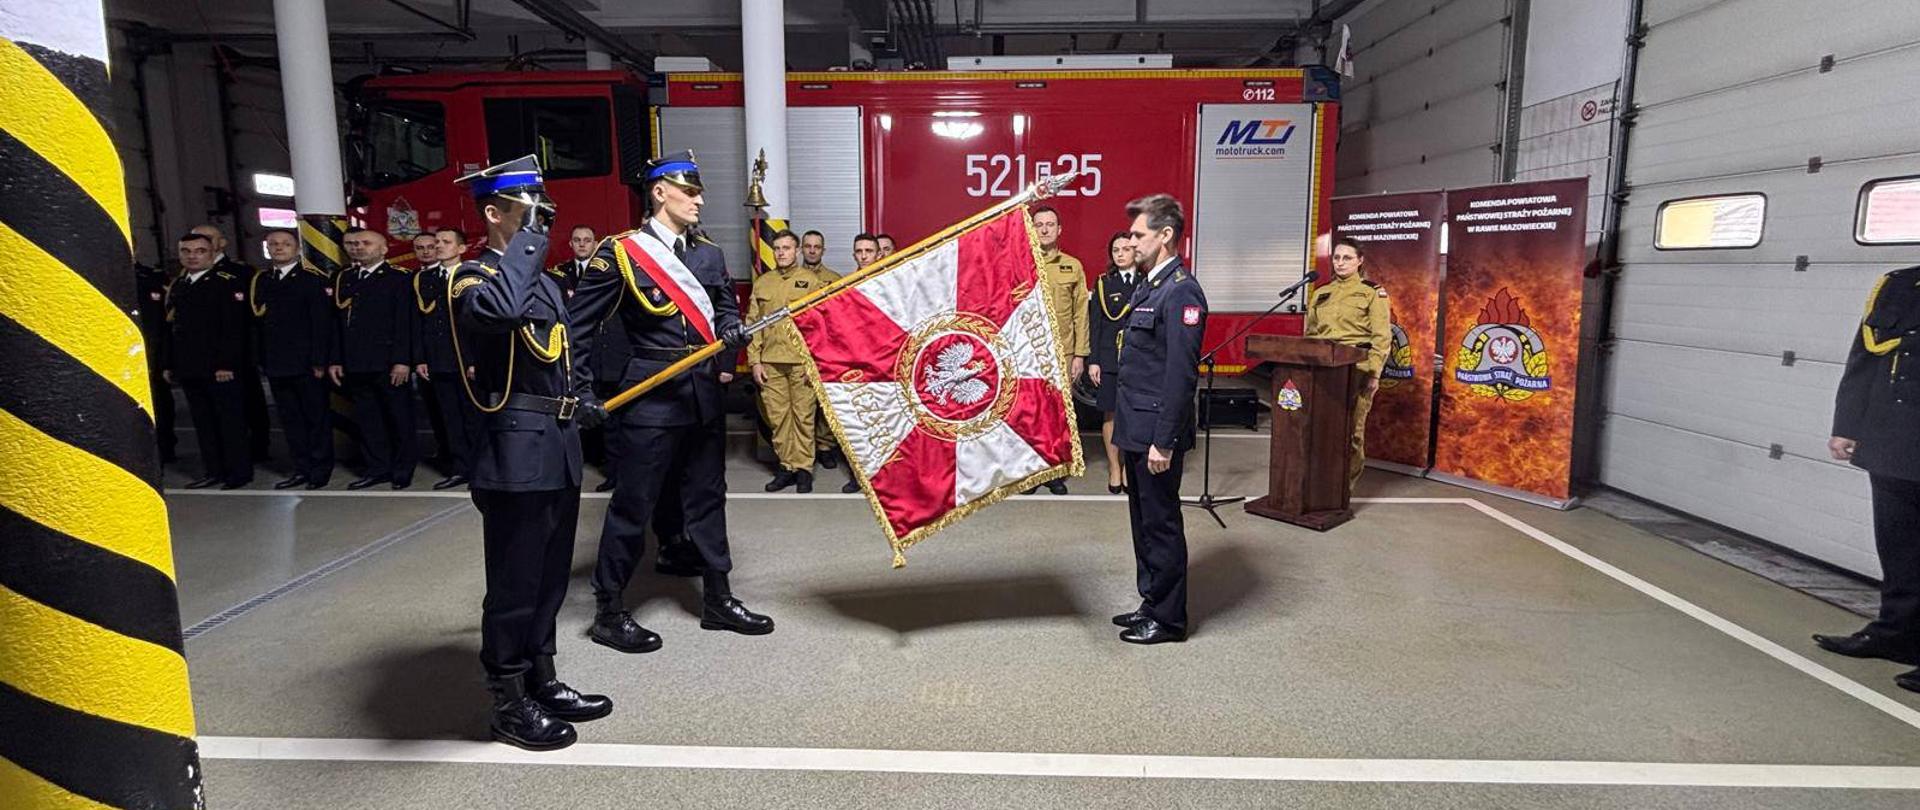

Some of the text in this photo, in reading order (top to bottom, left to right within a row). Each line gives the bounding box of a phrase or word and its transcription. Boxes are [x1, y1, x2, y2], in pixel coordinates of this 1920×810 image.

[1254, 88, 1275, 100] 112
[1216, 147, 1285, 156] mototruck.com
[1470, 195, 1556, 208] KOMENDA POWIATOWA
[1380, 210, 1419, 219] POWIATOWA
[1503, 208, 1532, 219] STRAŻY
[1532, 206, 1573, 217] POŻARNEJ
[1467, 222, 1557, 233] W RAWIE MAZOWIECKIEJ
[1514, 376, 1548, 388] POŻARNA
